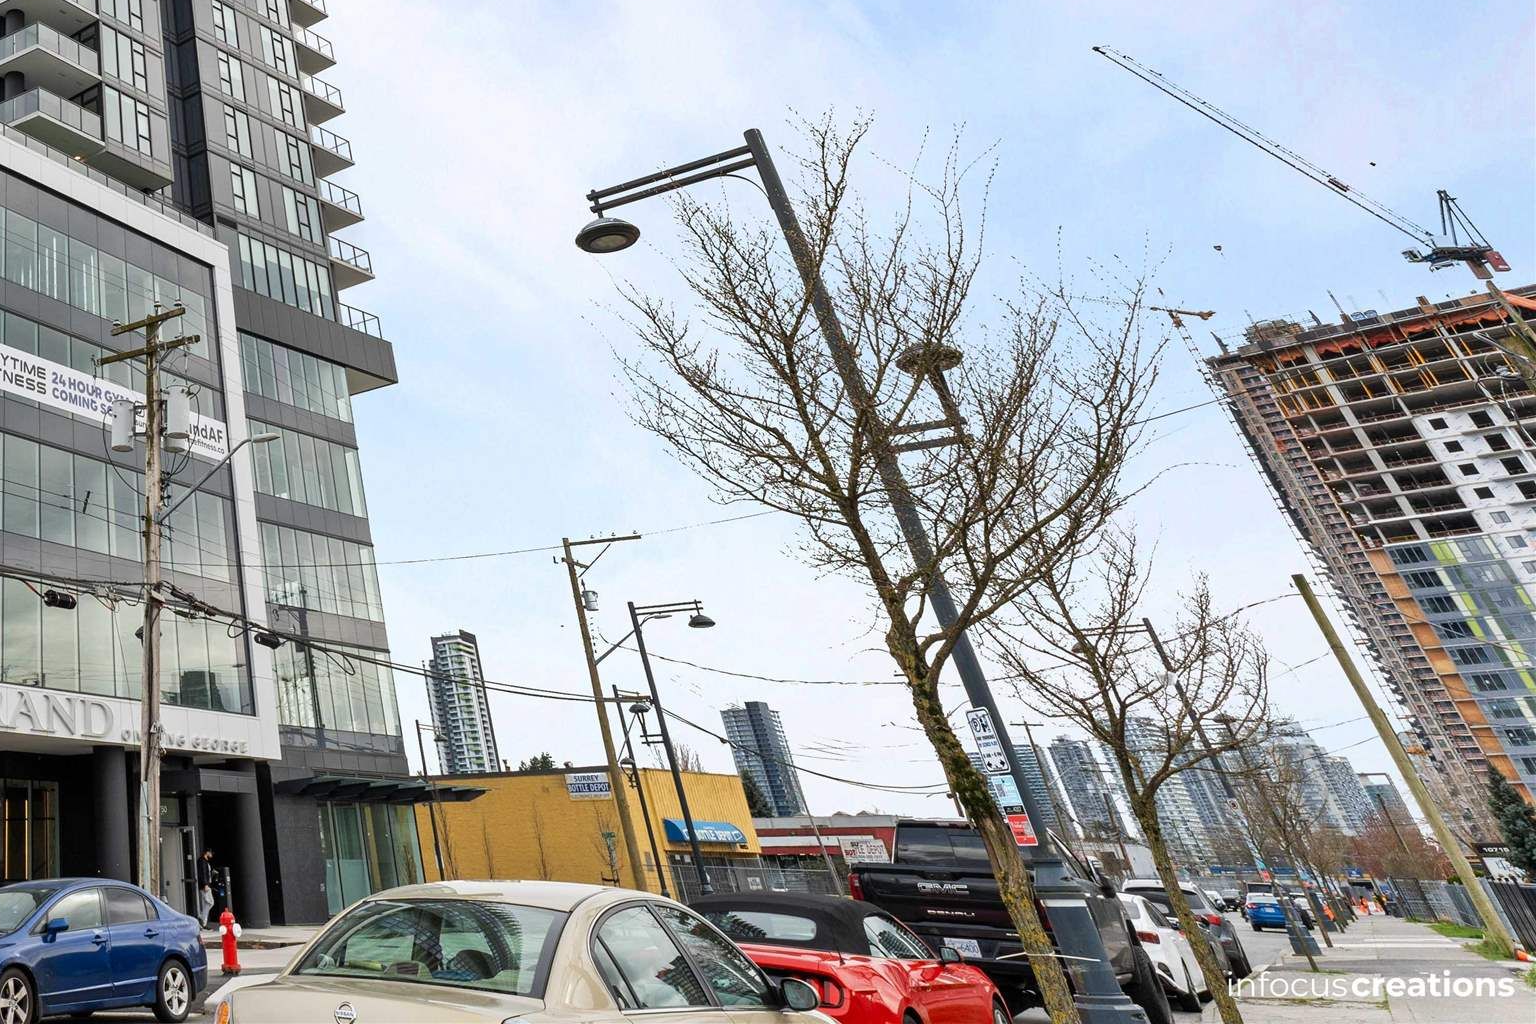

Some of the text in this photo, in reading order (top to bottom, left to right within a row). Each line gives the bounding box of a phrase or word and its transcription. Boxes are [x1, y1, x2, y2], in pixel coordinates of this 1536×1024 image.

[52, 372, 66, 387] 24
[68, 376, 102, 399] HOUR
[52, 387, 97, 410] COMING
[191, 736, 249, 754] GEORGE
[573, 774, 599, 783] SURREY
[568, 783, 609, 792] BOTTLE DEPOT
[866, 844, 884, 854] DEPOT
[917, 882, 970, 894] GMC
[927, 909, 976, 918] DENALI
